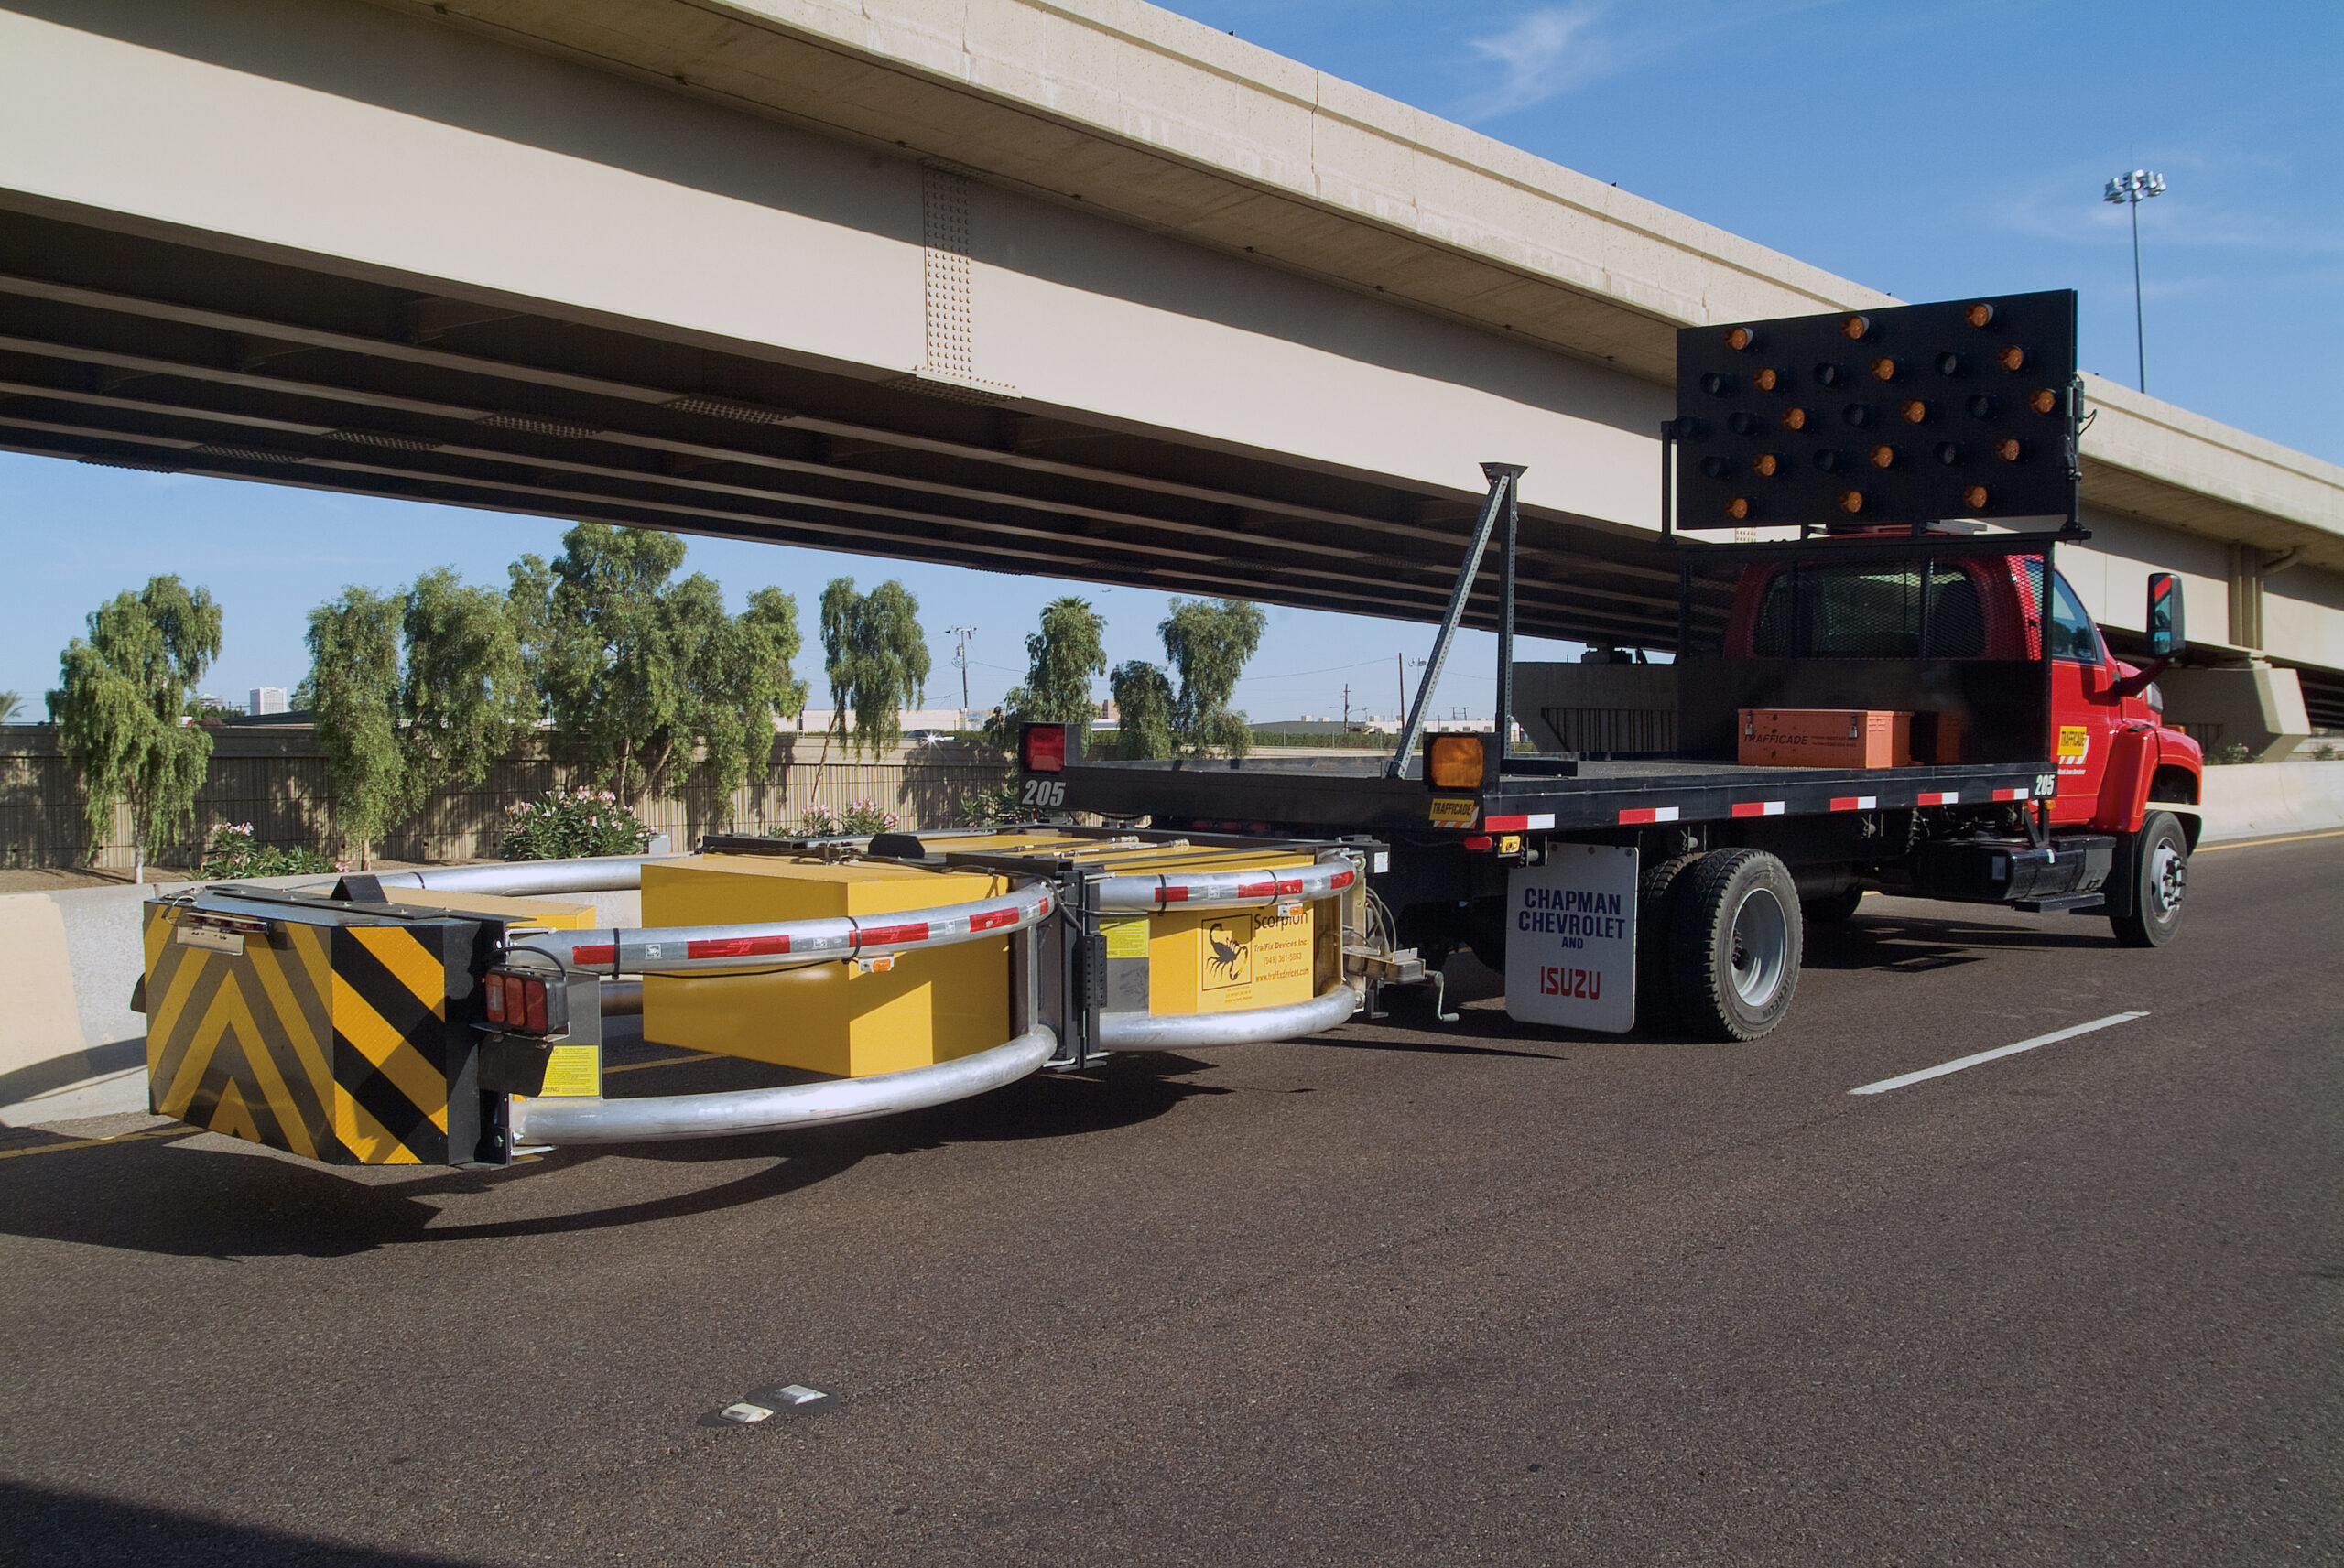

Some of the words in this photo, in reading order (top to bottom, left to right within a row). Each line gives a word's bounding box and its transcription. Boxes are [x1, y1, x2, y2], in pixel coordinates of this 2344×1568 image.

[1743, 733, 1808, 745] TRAFFICADE
[1022, 779, 1066, 806] 205
[2035, 774, 2055, 795] 205
[1432, 802, 1472, 816] TRAFFICADE
[1525, 887, 1621, 914] CHAPMAN
[1518, 911, 1625, 939] CHEVROLET
[1274, 940, 1297, 950] Devices
[1561, 936, 1584, 949] AND
[1540, 966, 1601, 1000] ISUZU
